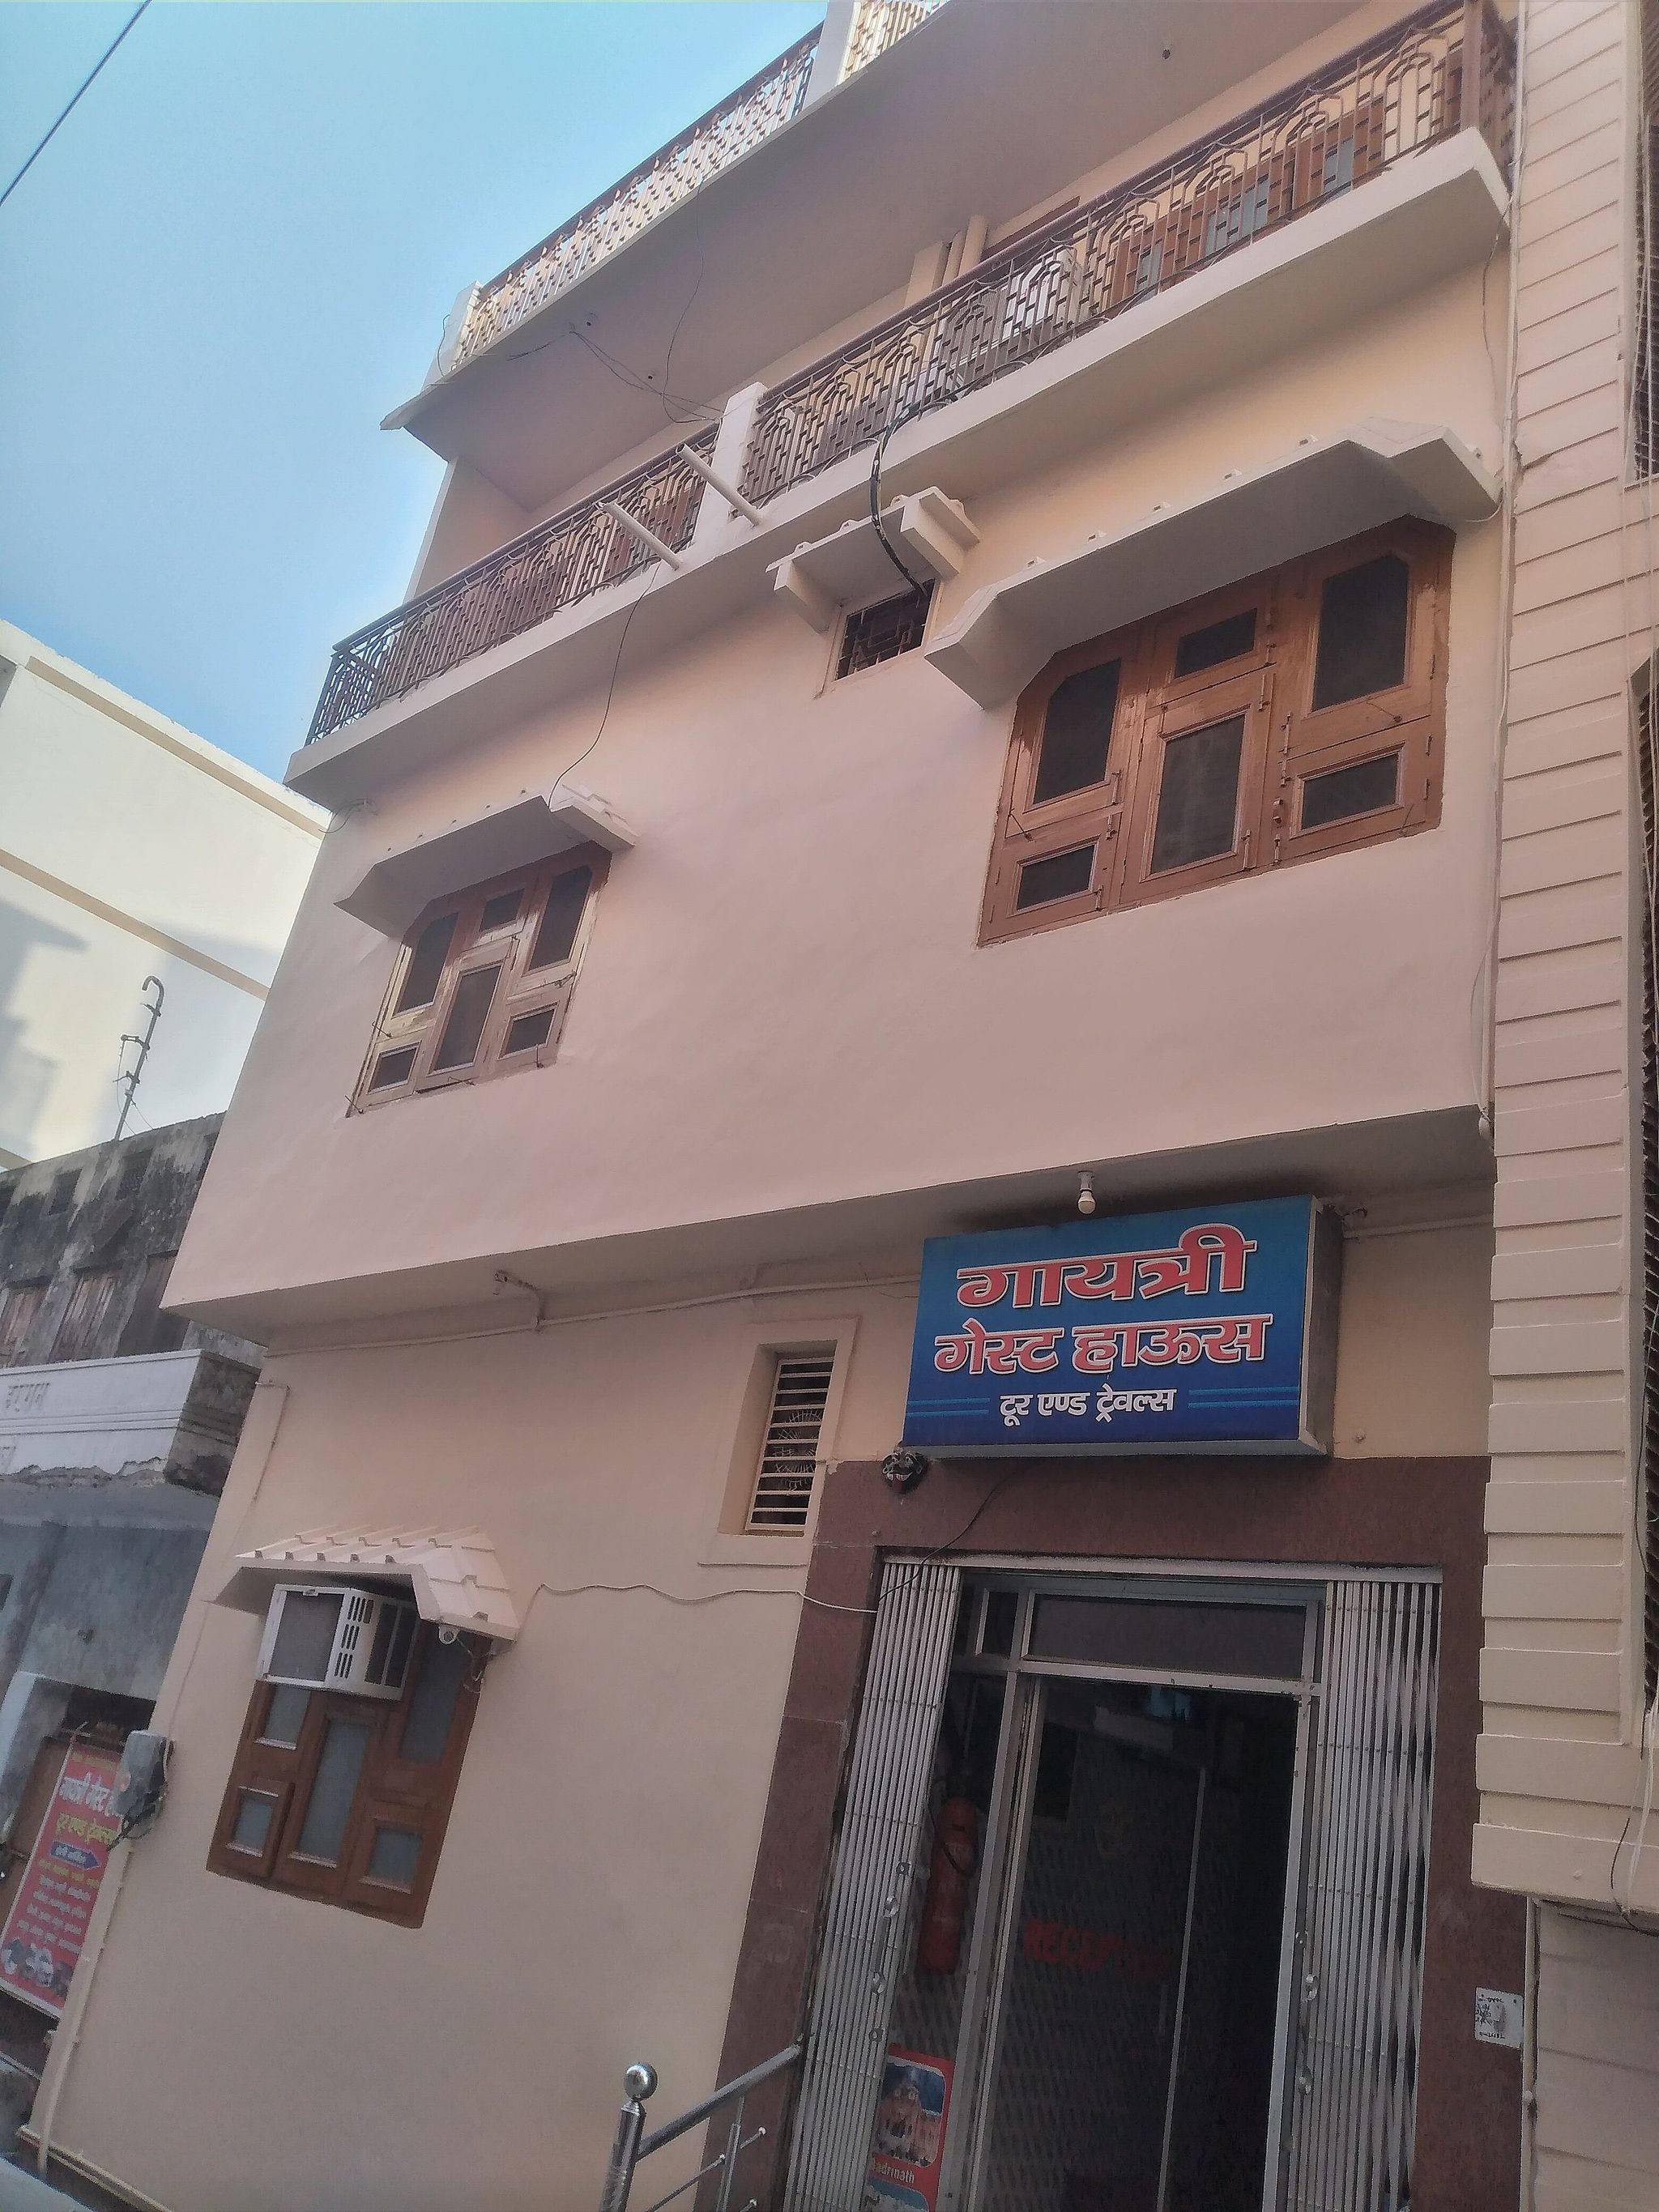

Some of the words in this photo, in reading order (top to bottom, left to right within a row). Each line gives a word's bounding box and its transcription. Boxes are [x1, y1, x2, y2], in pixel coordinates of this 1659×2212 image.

[957, 1222, 1257, 1308] गायत्री
[934, 1318, 1064, 1375] गेस्ट
[1072, 1313, 1273, 1374] हाऊस
[999, 1392, 1033, 1426] टूर
[1037, 1392, 1090, 1417] एण्ड
[1095, 1382, 1178, 1422] ट्रेवल्स
